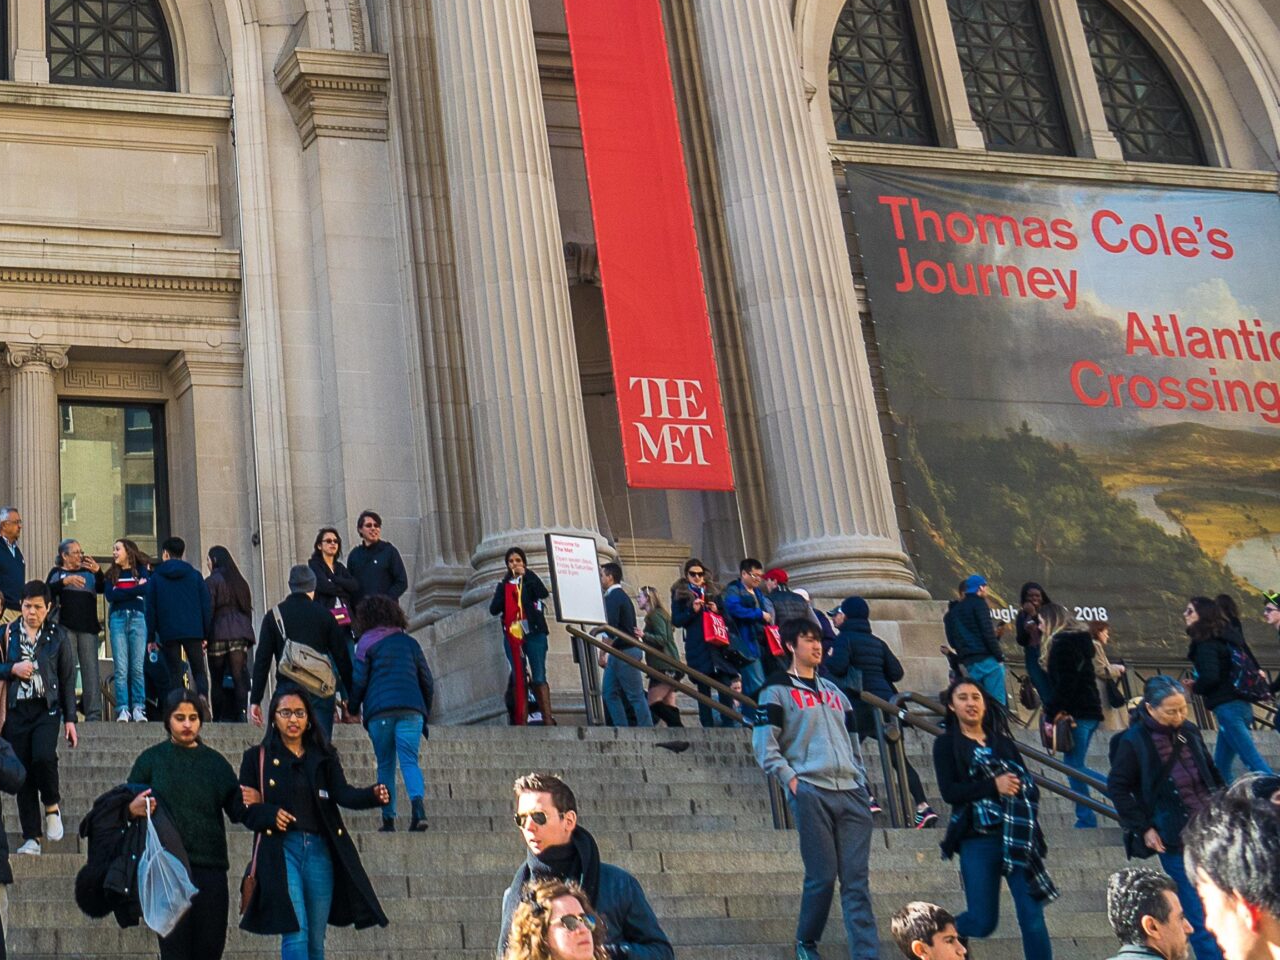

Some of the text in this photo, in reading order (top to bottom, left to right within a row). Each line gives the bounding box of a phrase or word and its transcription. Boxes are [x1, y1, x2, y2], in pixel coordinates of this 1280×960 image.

[878, 195, 1235, 260] Thomas Cole's
[895, 246, 1078, 310] Journey
[629, 376, 707, 420] THE
[1069, 360, 1280, 424] Crossing
[632, 422, 713, 466] MET
[1073, 605, 1109, 621] 2018
